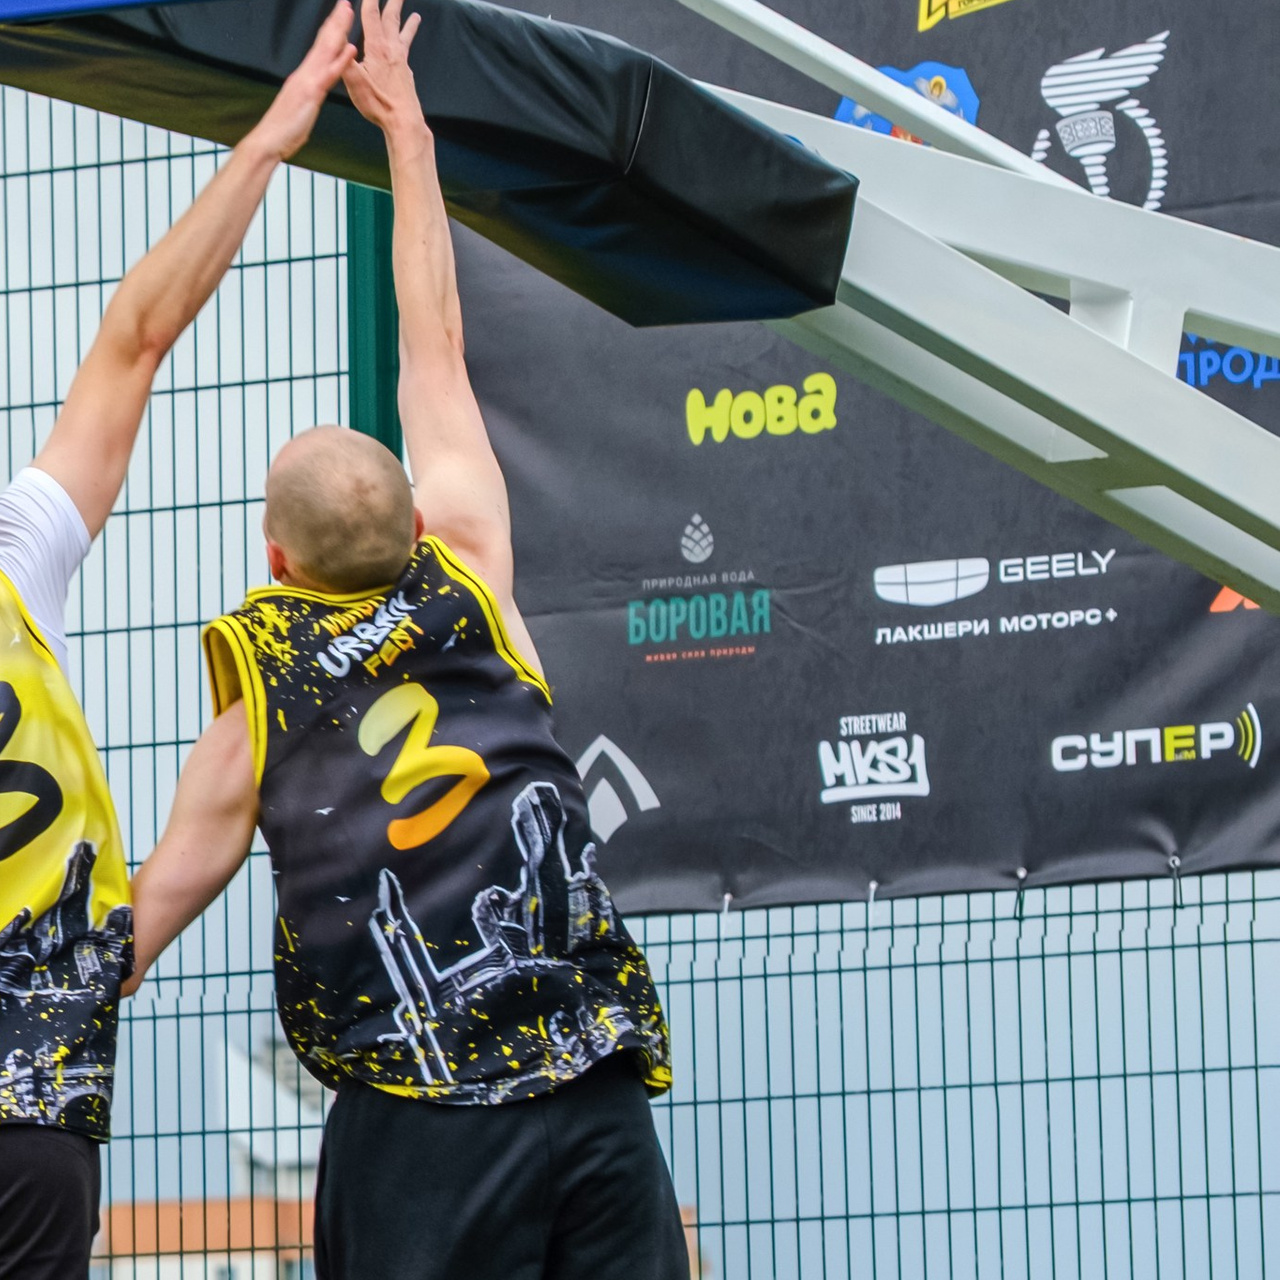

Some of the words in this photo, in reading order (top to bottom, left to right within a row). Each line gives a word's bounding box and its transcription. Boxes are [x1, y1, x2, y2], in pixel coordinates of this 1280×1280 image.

[642, 574, 717, 591] ПРИРОДНАЯ
[722, 570, 755, 583] ВОДА
[999, 549, 1116, 583] GEELY
[628, 588, 771, 645] БОРОВАЯ
[875, 618, 989, 645] ЛАКШЕРИ
[317, 590, 417, 678] URBAN
[840, 711, 907, 737] STREETWEAR
[358, 682, 491, 850] 3
[851, 804, 877, 824] SINCE
[880, 801, 902, 821] 2014
